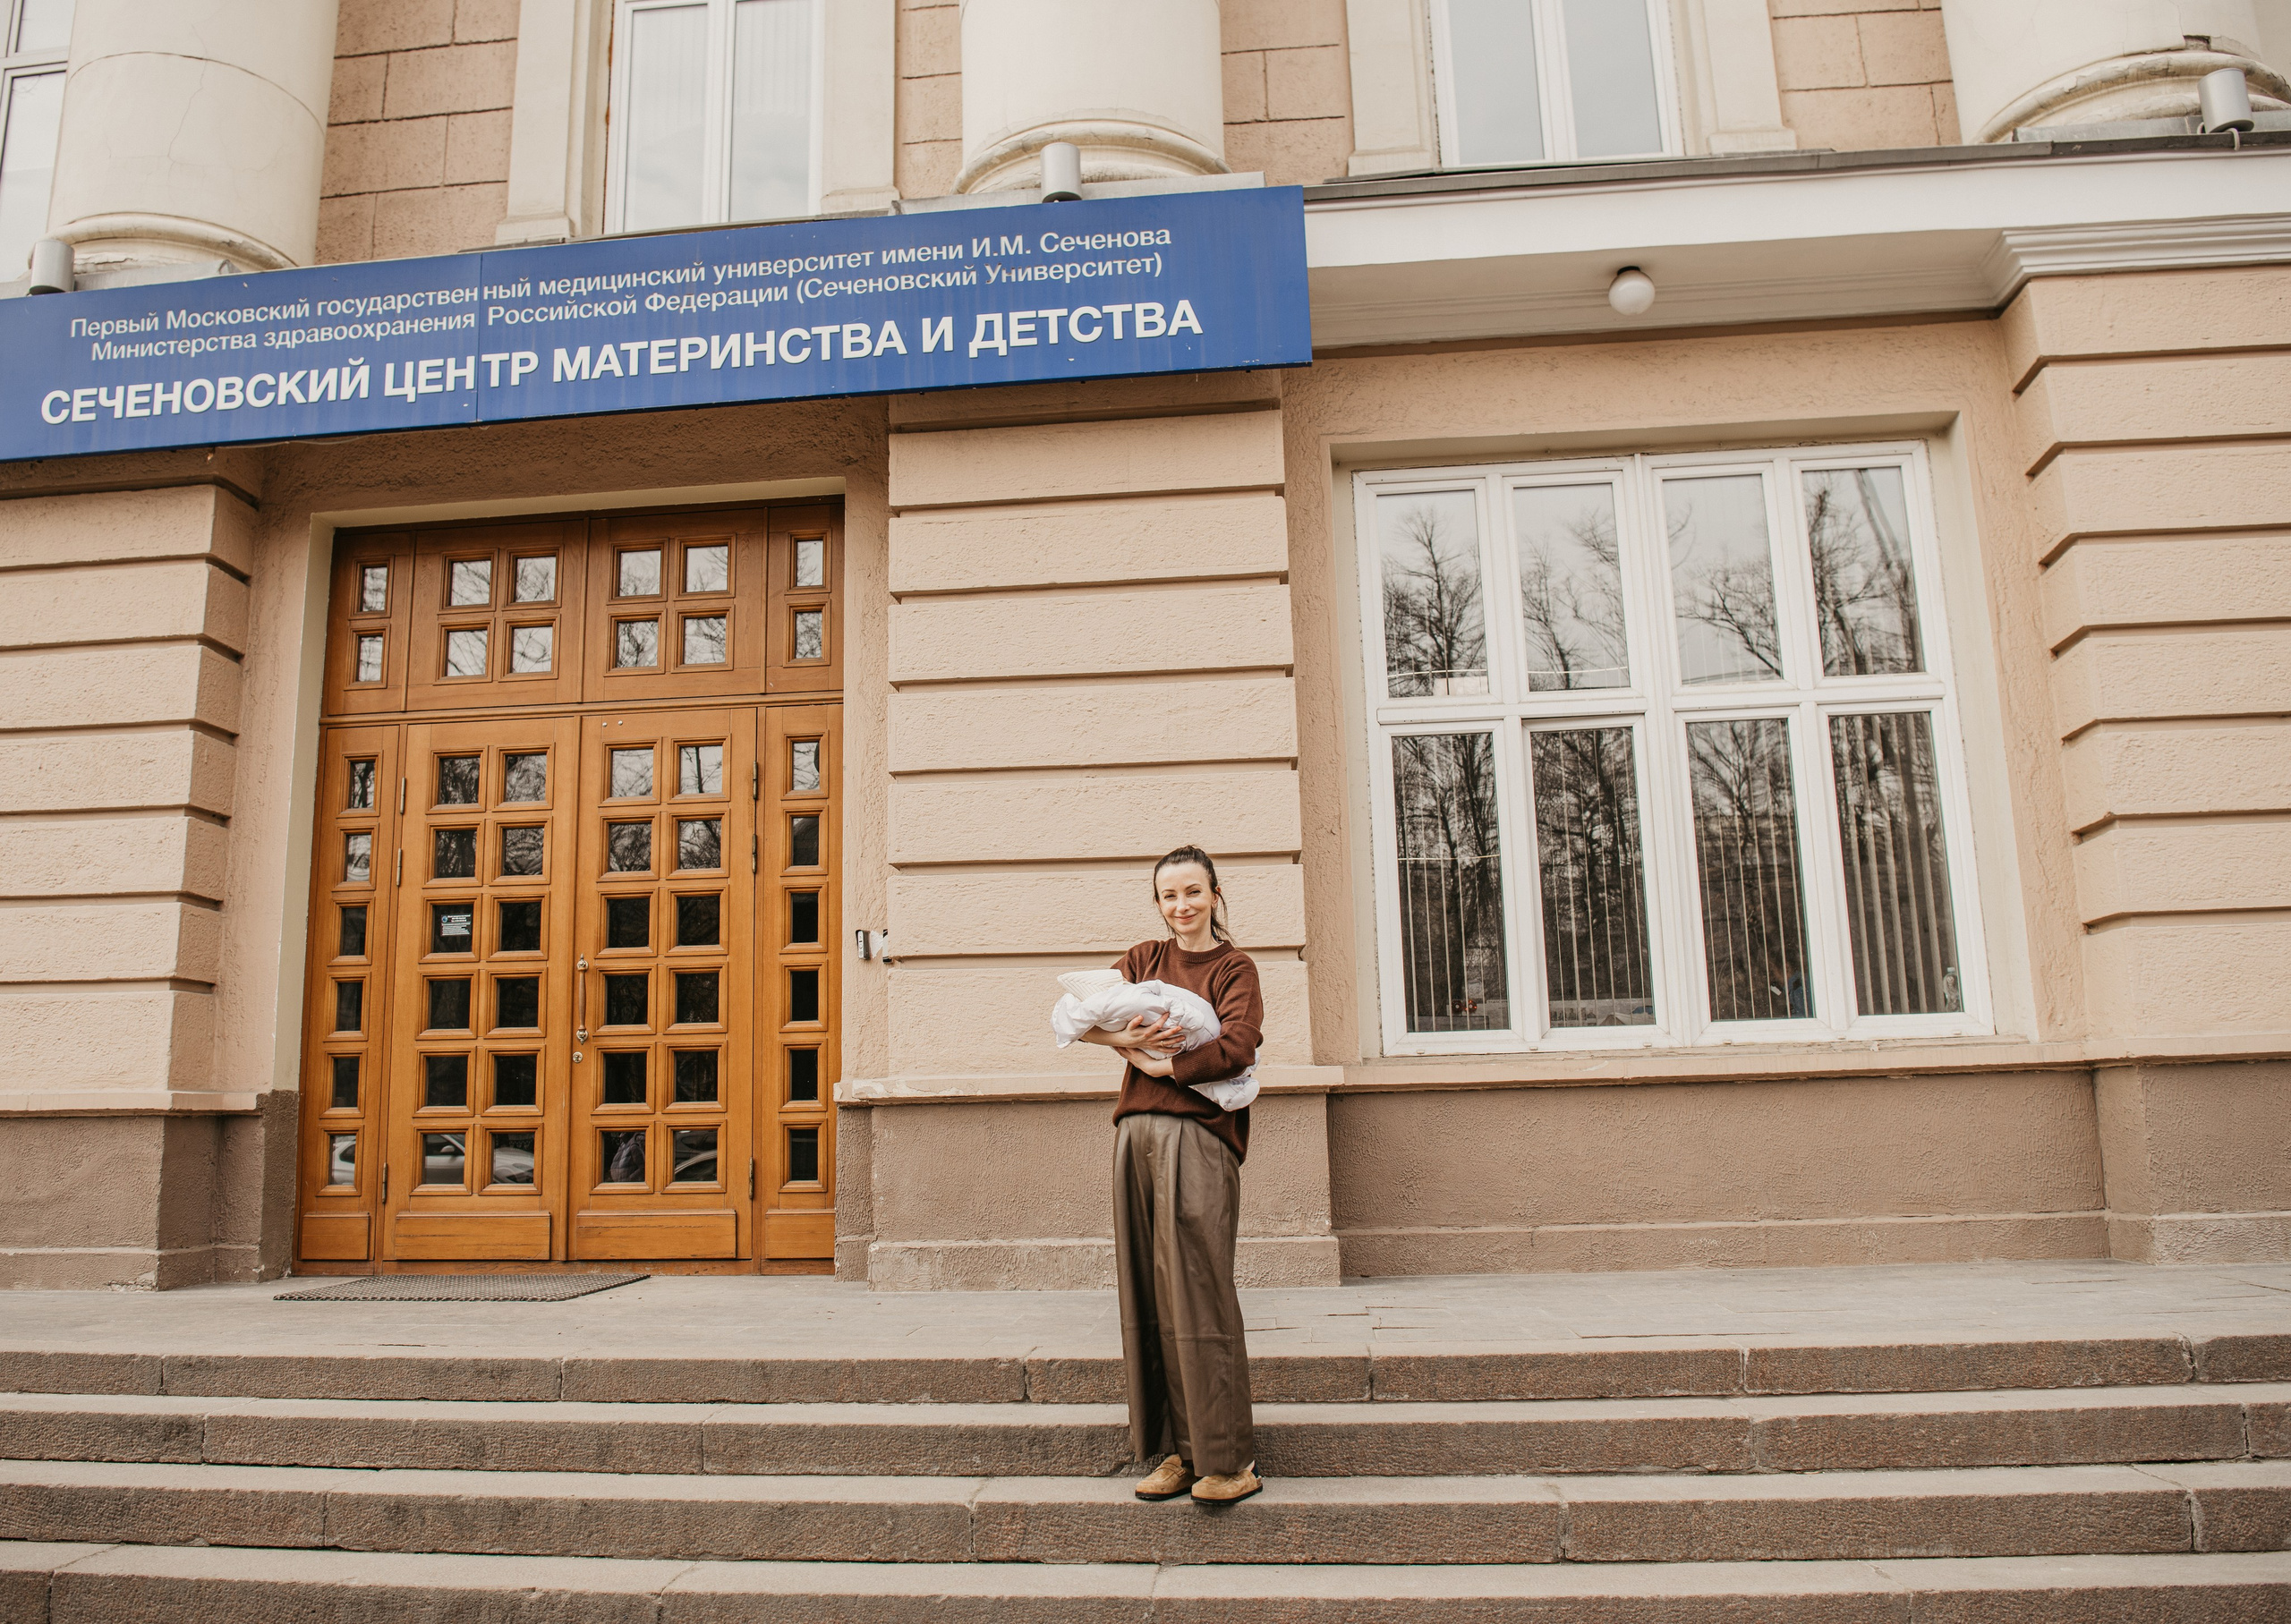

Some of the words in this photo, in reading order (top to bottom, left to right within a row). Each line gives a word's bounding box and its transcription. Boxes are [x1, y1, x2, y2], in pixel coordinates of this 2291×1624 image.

[70, 311, 159, 340] Первый
[166, 298, 310, 330] Московский
[317, 276, 531, 319] государственный
[539, 260, 705, 297] медицинский
[712, 251, 875, 285] университет
[881, 244, 963, 265] имени
[972, 234, 1031, 258] И.М.
[1039, 228, 1172, 253] Сеченова
[90, 333, 258, 361] Министерства
[263, 312, 475, 350] здравоохранения
[488, 293, 637, 326] Российской
[644, 285, 788, 315] Федерации
[796, 265, 977, 304] (Сеченовский
[984, 251, 1163, 285] Университет)
[40, 356, 370, 424] СЕЧЕНОВСКИЙ
[383, 350, 539, 403] ЦЕНТР
[552, 319, 907, 383] МАТЕРИНСТВА
[921, 316, 954, 353] И
[968, 299, 1204, 359] ДЕТСТВА
